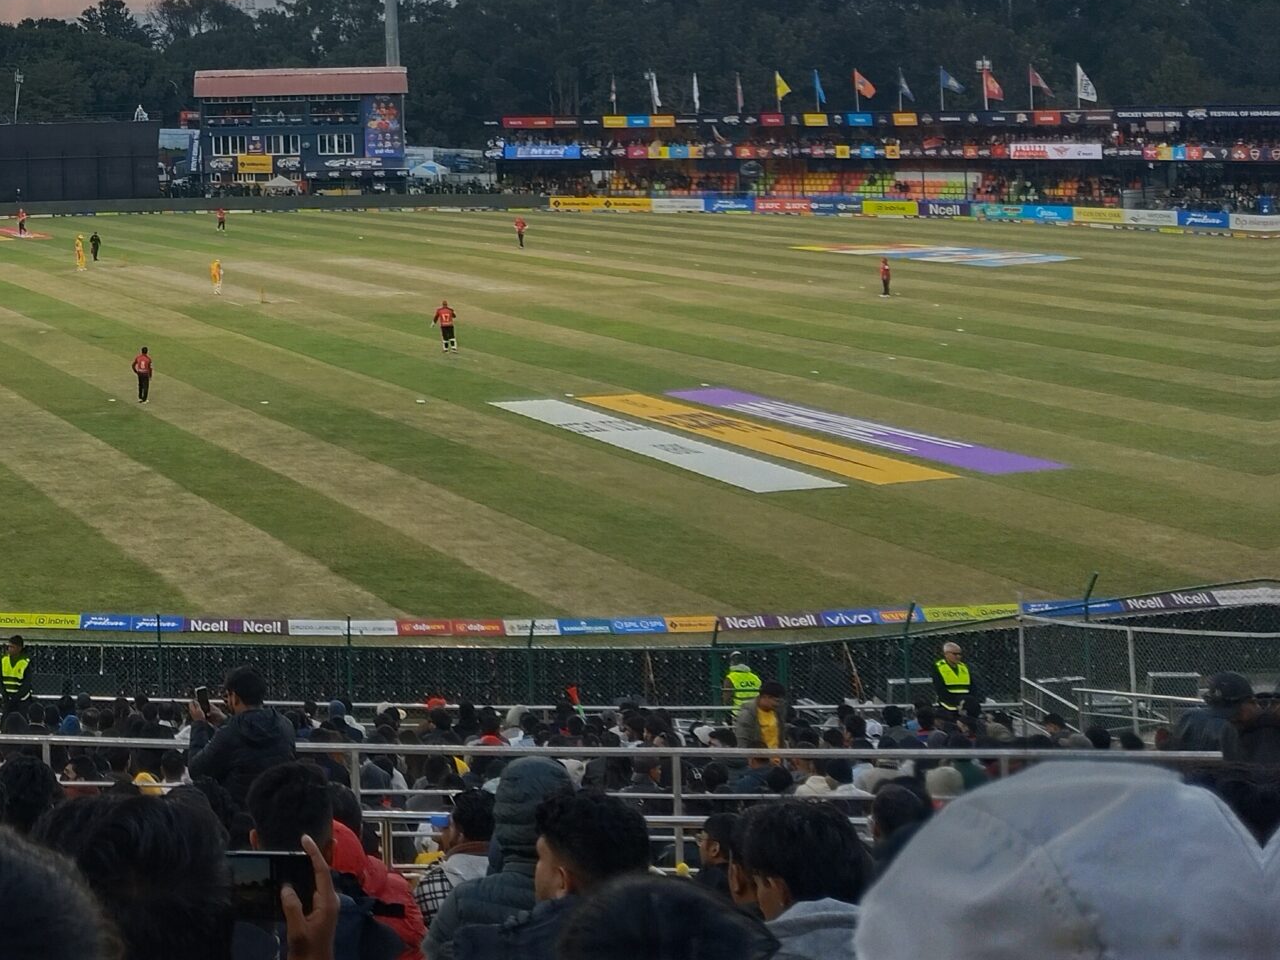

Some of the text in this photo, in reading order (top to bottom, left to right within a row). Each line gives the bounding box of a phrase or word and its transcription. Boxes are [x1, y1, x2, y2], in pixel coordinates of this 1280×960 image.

[929, 204, 960, 216] Ncell
[442, 313, 450, 321] 17
[1126, 596, 1166, 610] Ncell
[1170, 592, 1211, 605] Ncell
[47, 617, 76, 625] inDrive
[190, 619, 228, 632] Ncell
[725, 616, 765, 629] Ncell
[776, 614, 817, 628] Ncell
[826, 613, 872, 625] vivo
[242, 620, 282, 633] Ncell
